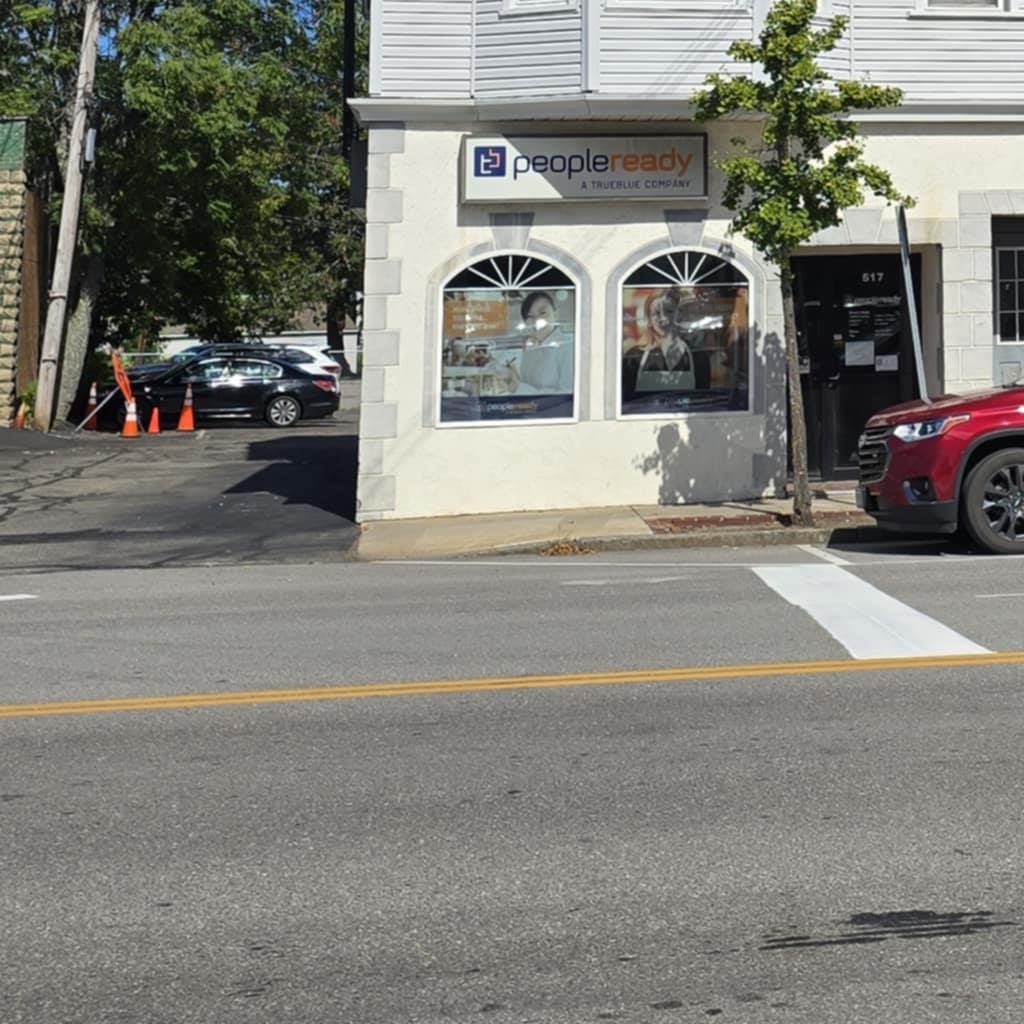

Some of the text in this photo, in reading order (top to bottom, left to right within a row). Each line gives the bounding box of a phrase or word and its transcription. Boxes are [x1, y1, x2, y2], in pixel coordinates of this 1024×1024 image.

[513, 146, 693, 180] peopleready
[581, 179, 692, 190] A TRUEBLUE COMPANY
